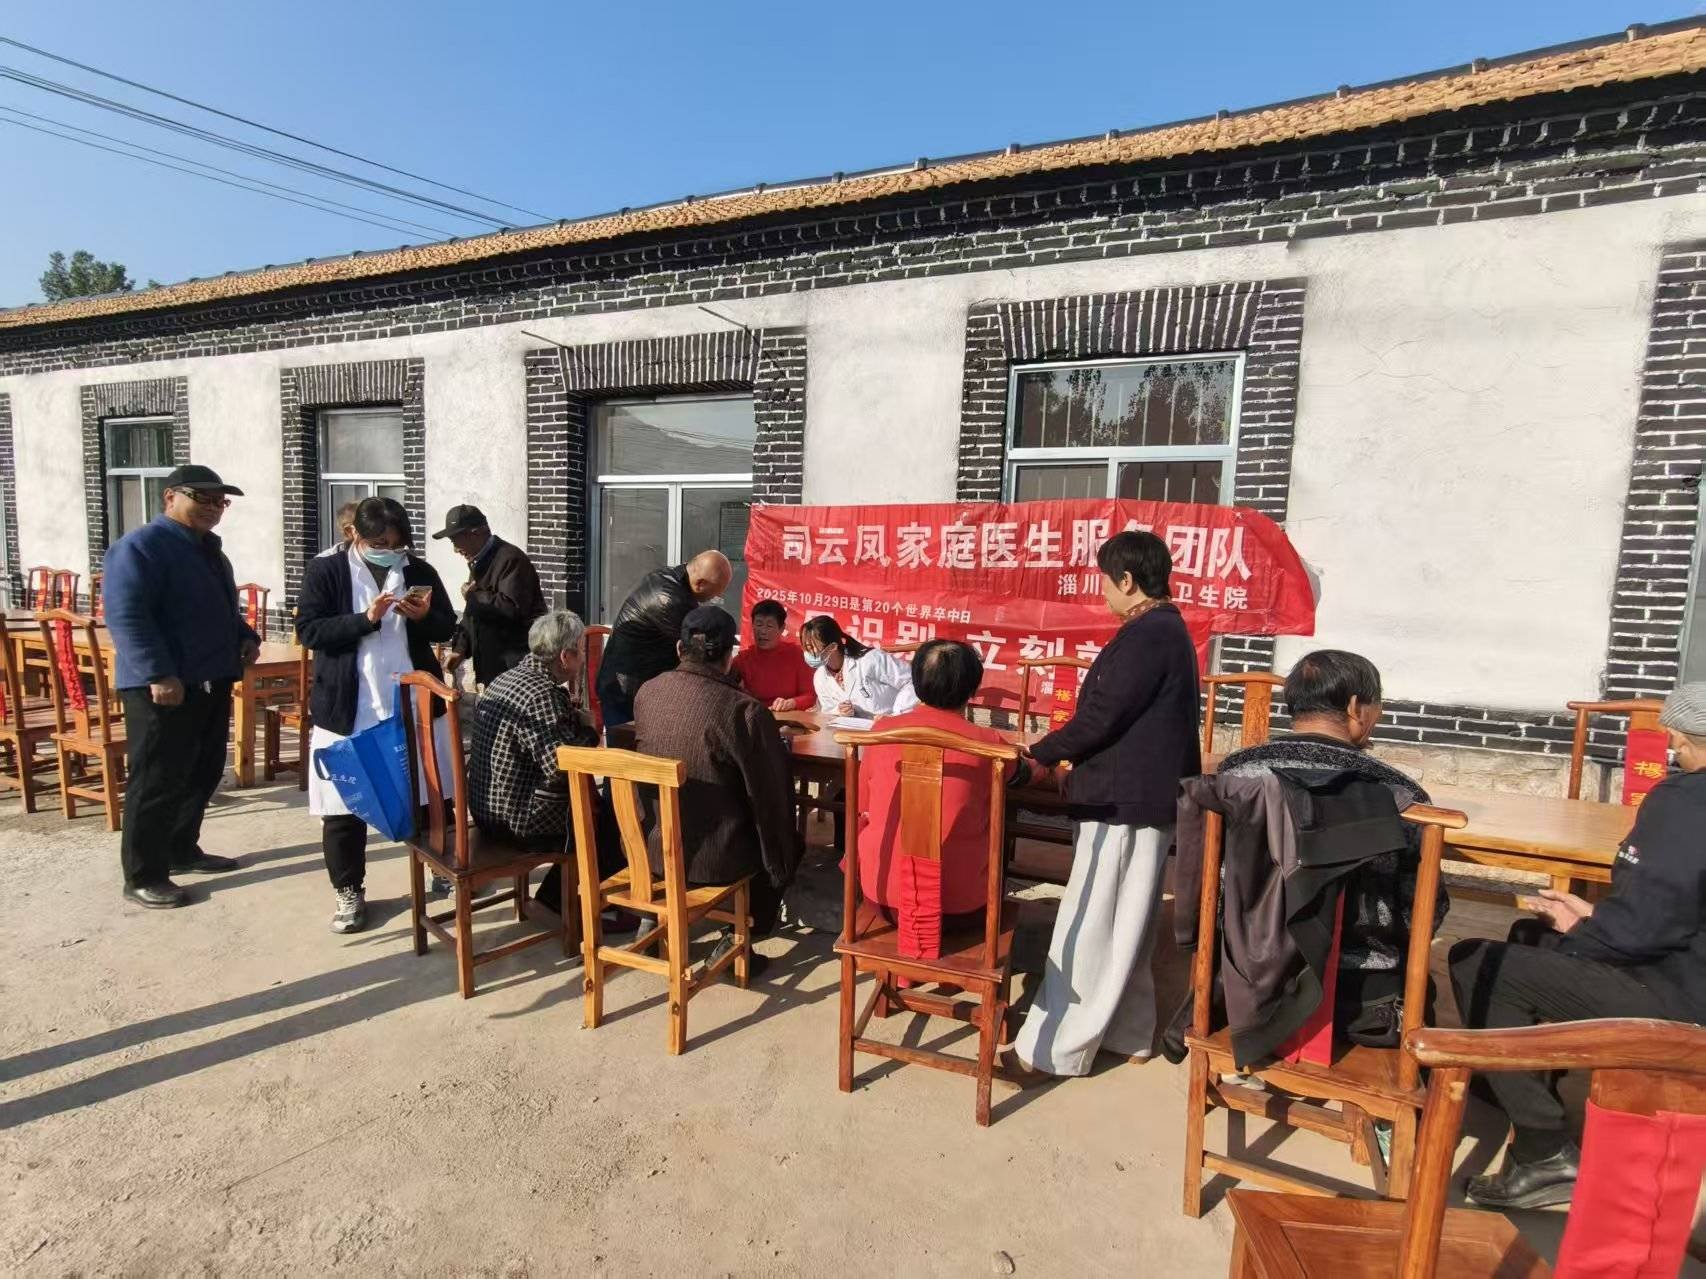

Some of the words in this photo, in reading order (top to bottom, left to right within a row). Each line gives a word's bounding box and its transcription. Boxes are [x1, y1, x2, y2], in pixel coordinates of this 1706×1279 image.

[782, 518, 1253, 581] 司云凤家庭医生服团队
[756, 587, 972, 624] 2025年10月29日是第20个世界卒中日
